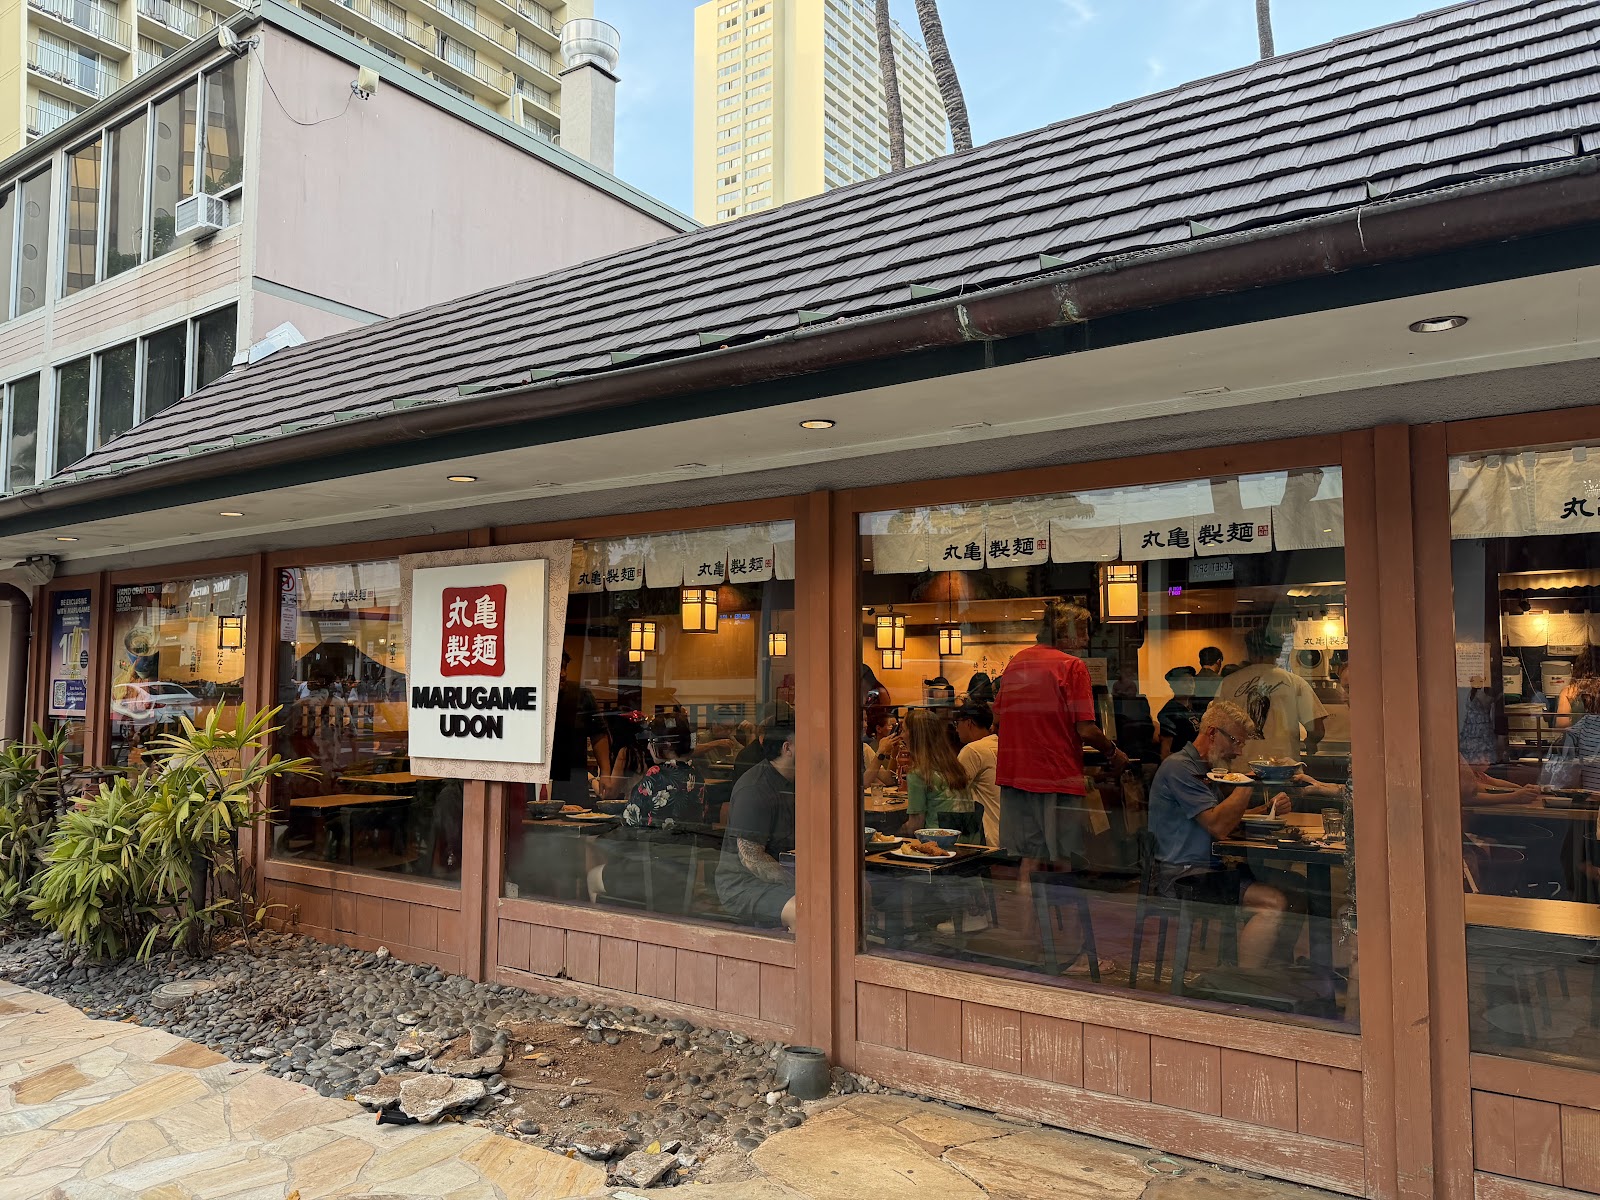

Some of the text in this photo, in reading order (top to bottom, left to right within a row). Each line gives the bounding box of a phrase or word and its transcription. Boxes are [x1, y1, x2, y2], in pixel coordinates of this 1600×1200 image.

[1560, 496, 1600, 520] 丸
[1141, 522, 1255, 549] 丸亀製麺
[943, 537, 1035, 561] 丸亀製麺
[577, 567, 636, 586] 丸亀製麺
[697, 557, 764, 577] 丸亀製麺
[445, 593, 499, 629] 丸亀
[445, 634, 498, 667] 製麺
[411, 685, 537, 711] MARUGAME
[439, 714, 504, 739] UDON
